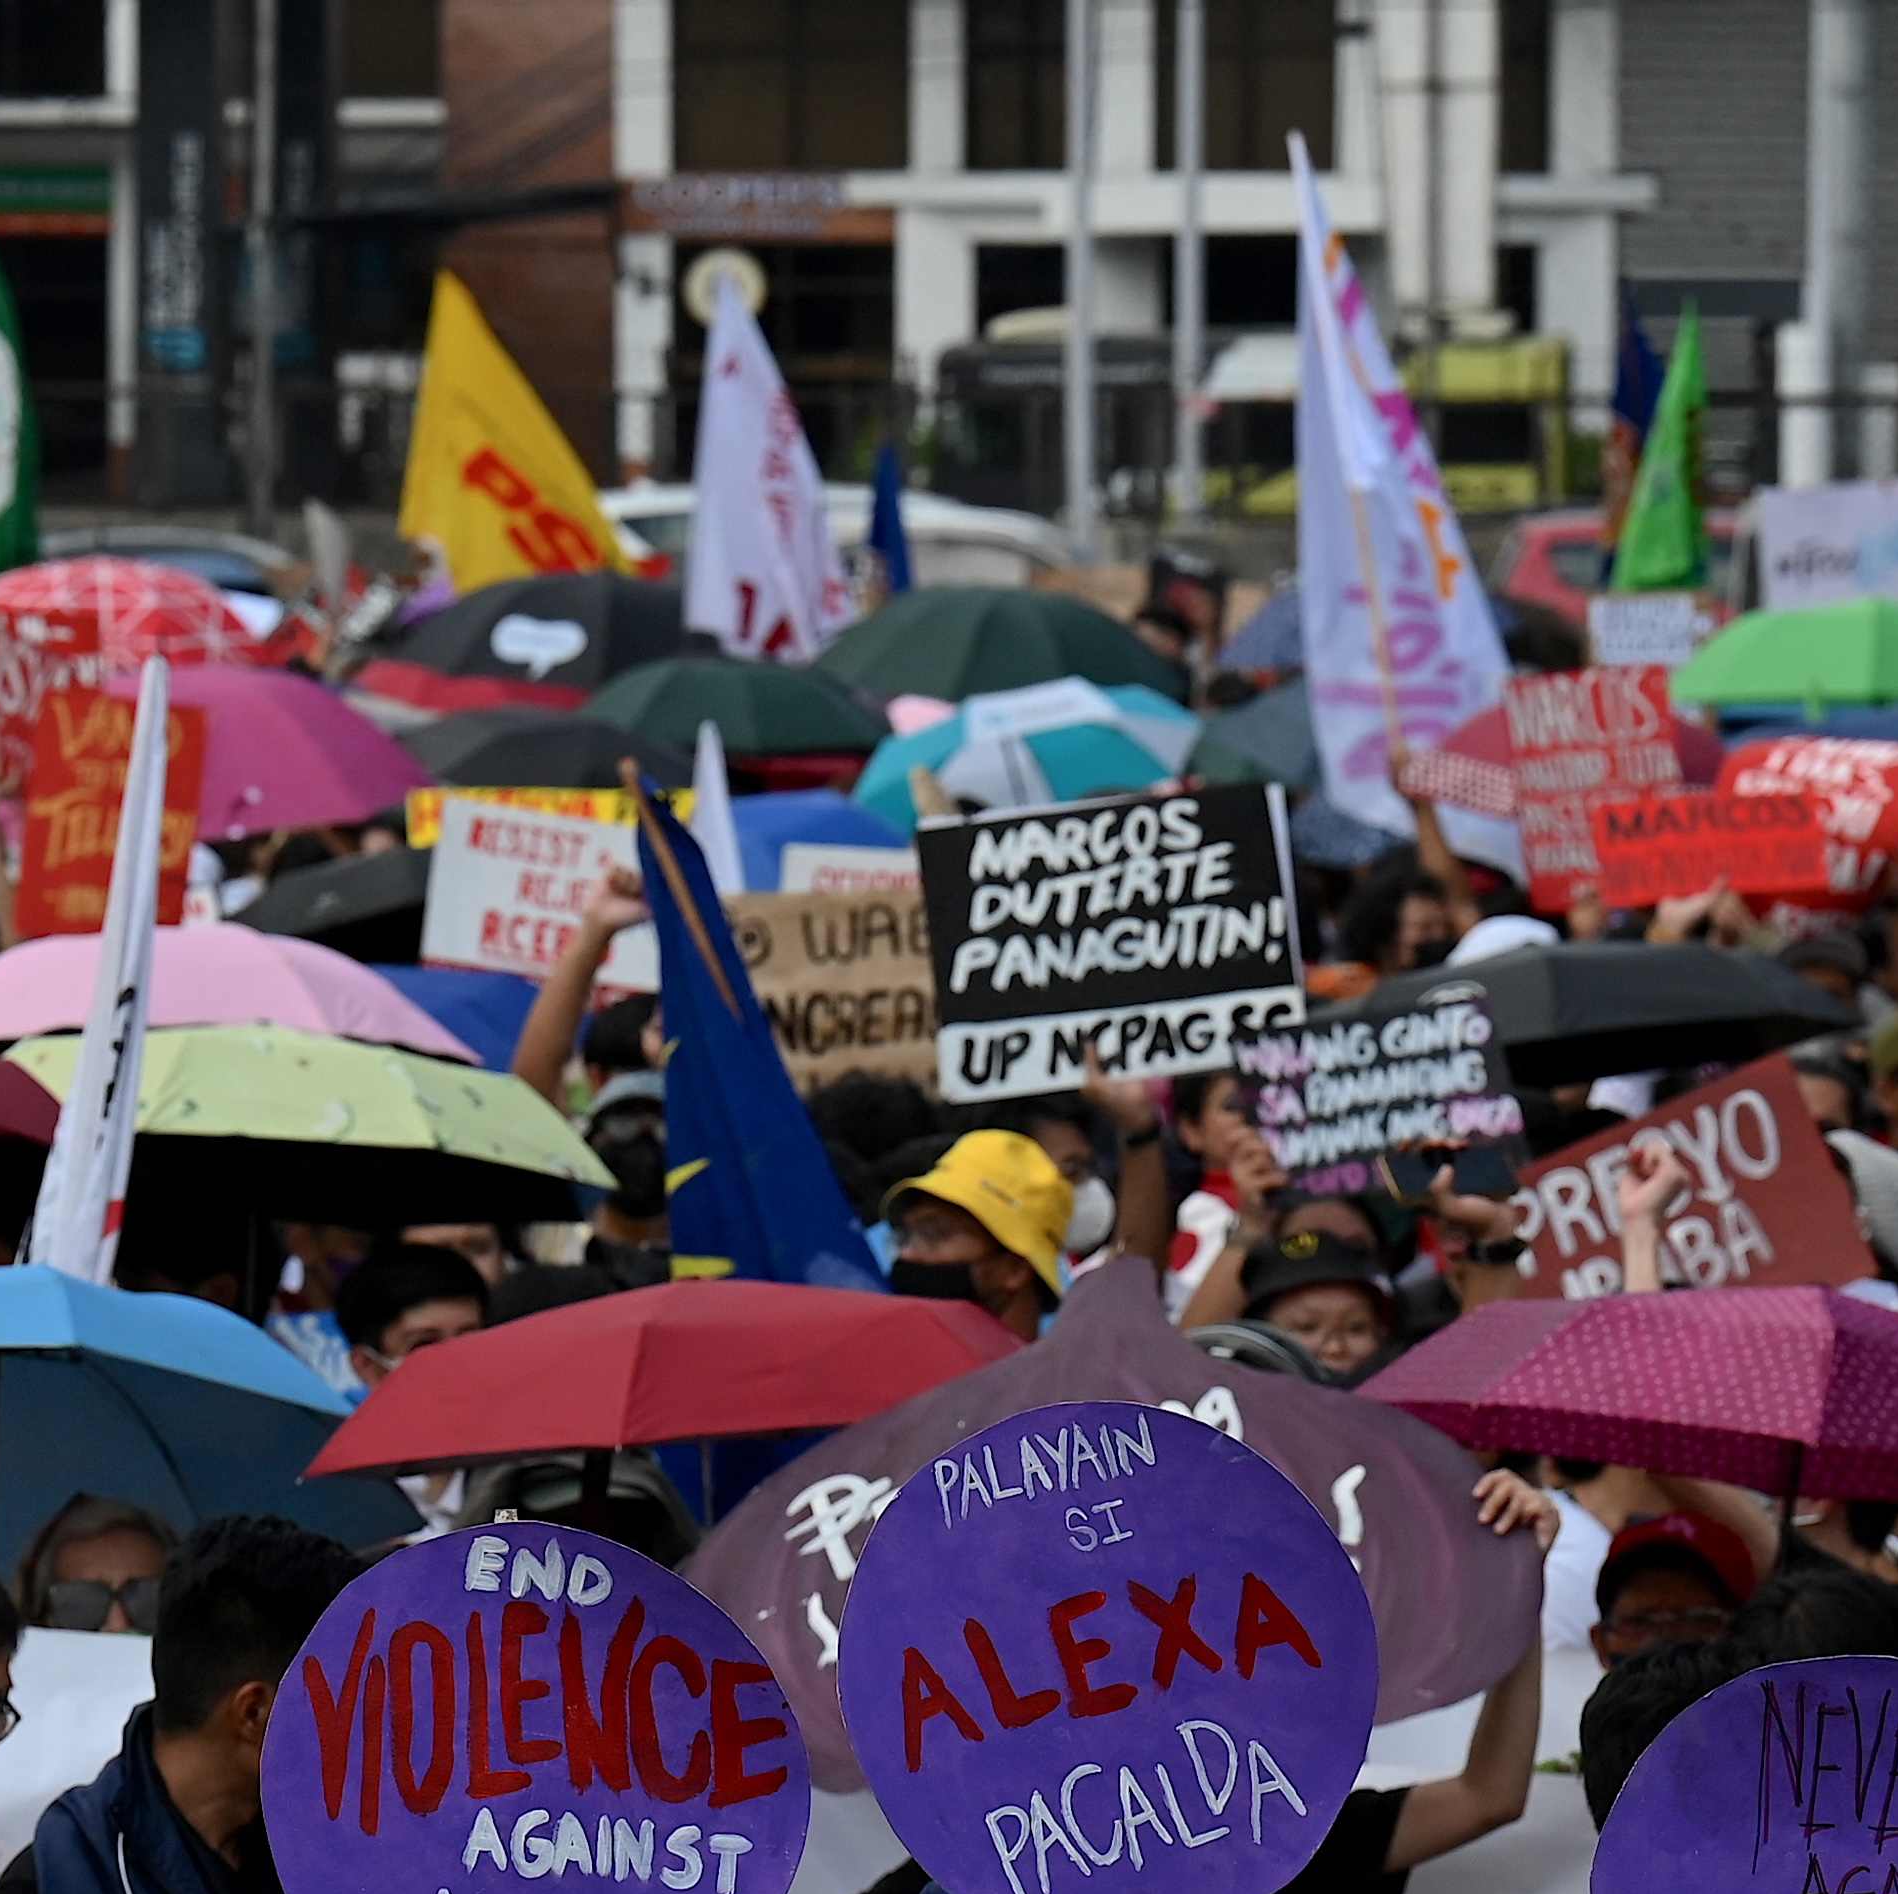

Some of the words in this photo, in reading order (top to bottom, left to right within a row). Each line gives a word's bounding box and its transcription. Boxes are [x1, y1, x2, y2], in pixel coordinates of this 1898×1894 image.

[967, 797, 1204, 883] MARCOS
[968, 840, 1236, 933] DUTERTE
[949, 895, 1288, 994] PANAGUTIN!
[959, 1031, 1032, 1085] UP
[1510, 1087, 1784, 1260] PREYO
[934, 1410, 1158, 1530] PALAYAIN
[464, 1533, 615, 1607] END
[1063, 1496, 1134, 1553] SI
[303, 1593, 790, 1837] VIOLENCE
[899, 1571, 1323, 1774] ALEXA
